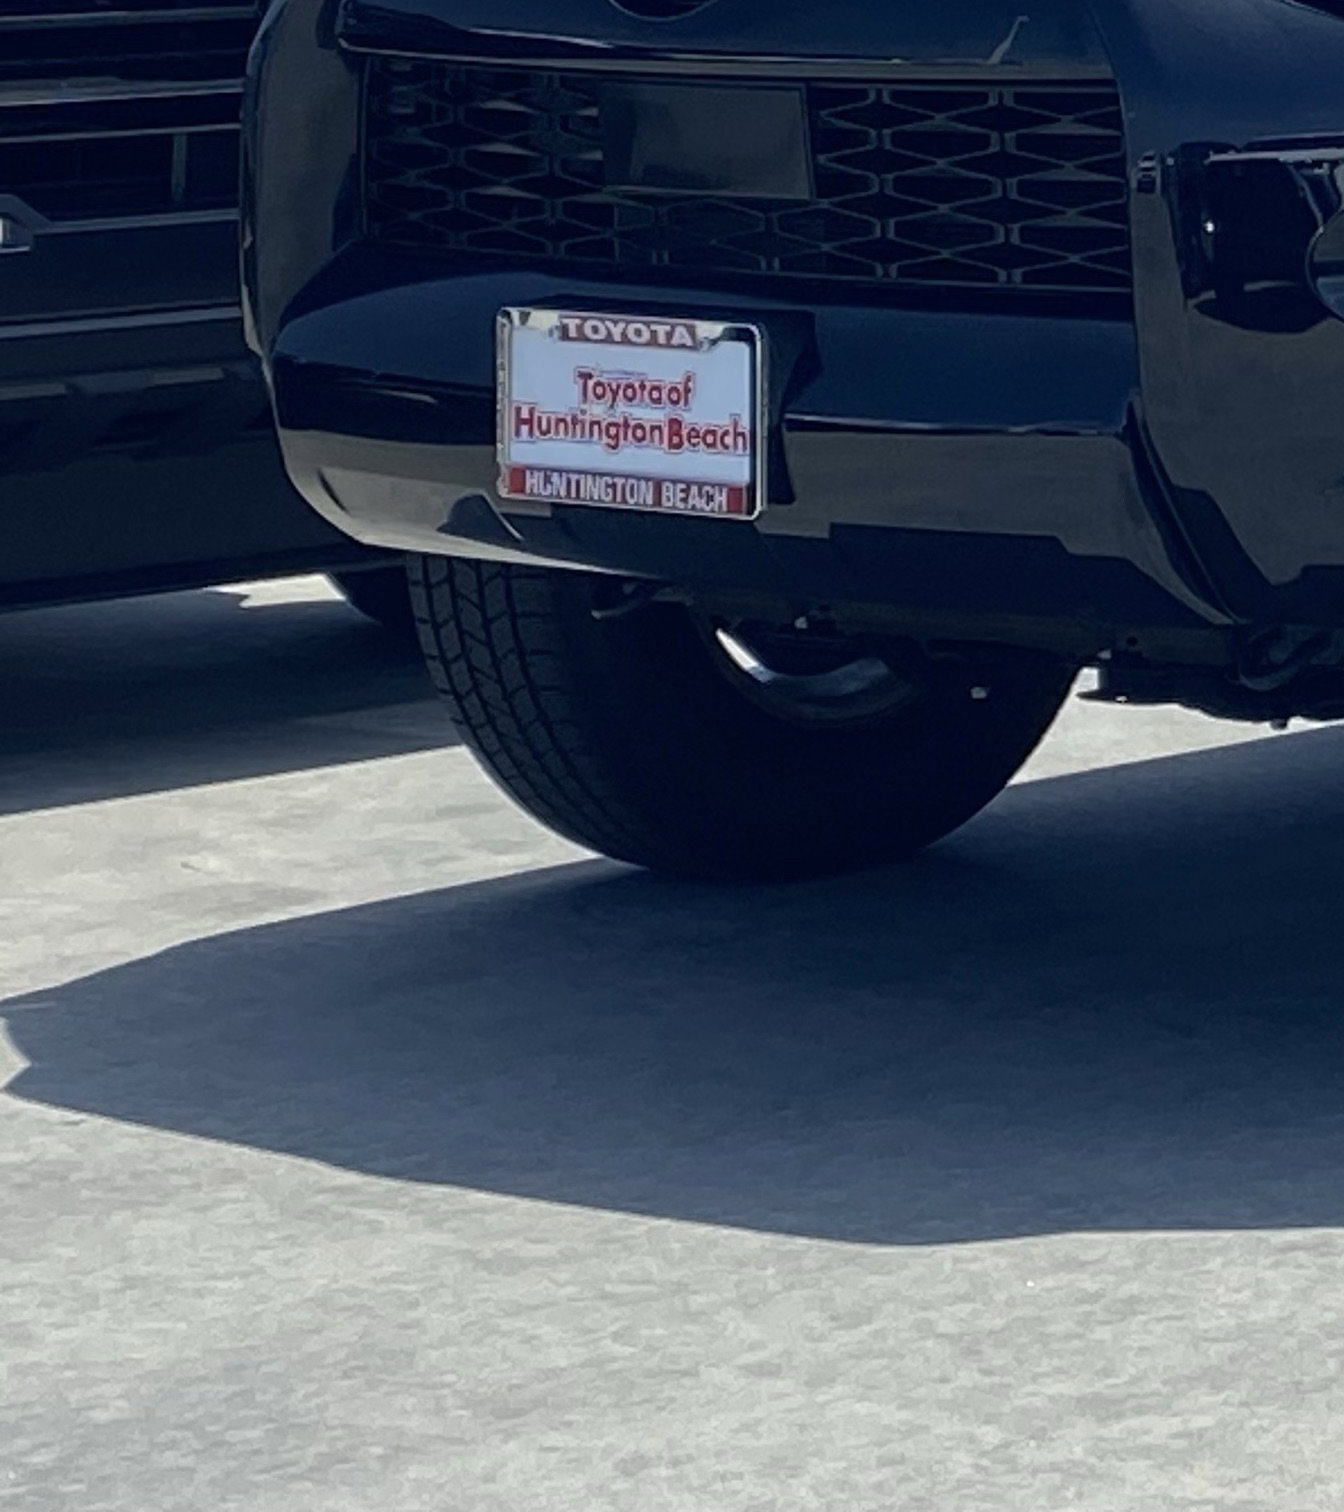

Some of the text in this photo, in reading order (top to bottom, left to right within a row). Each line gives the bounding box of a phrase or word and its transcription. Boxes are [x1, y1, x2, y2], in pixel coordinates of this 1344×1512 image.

[560, 318, 696, 347] TOYOTA
[576, 369, 693, 410] Toyota of
[524, 469, 727, 512] HUNTINGTON BEACH
